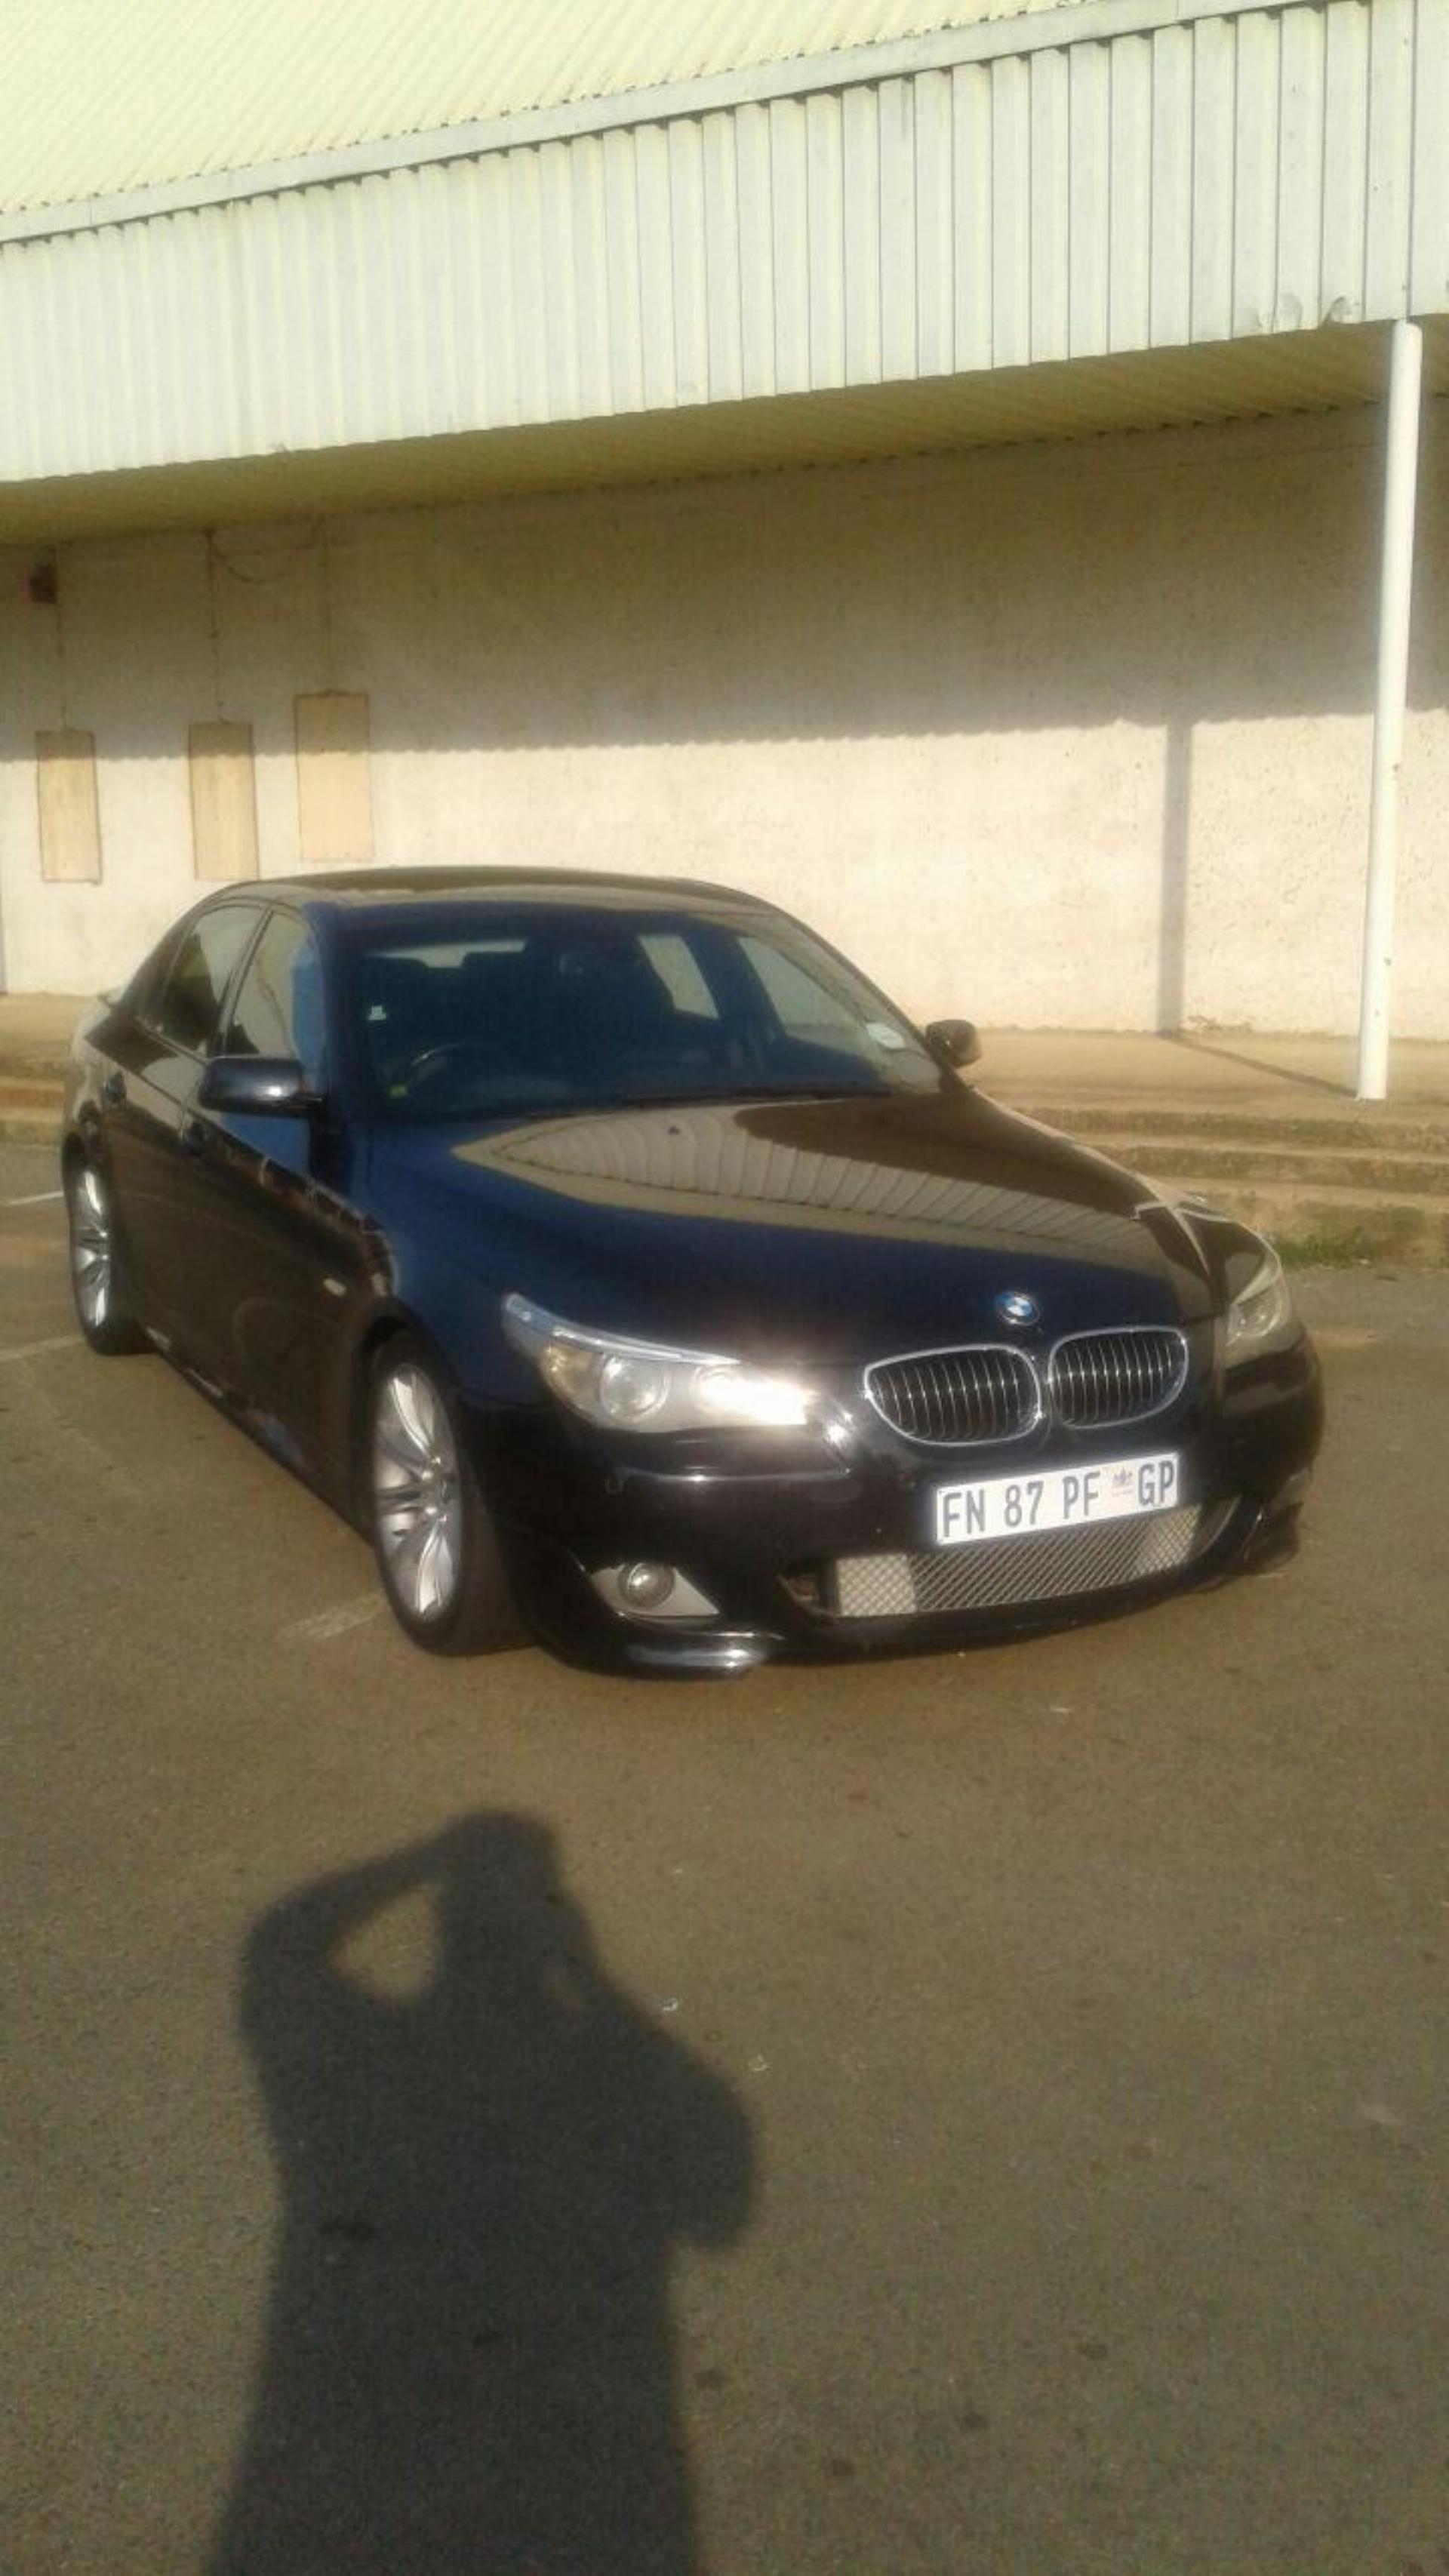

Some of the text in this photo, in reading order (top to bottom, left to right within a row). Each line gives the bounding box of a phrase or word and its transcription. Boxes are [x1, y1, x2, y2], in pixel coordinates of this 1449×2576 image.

[943, 1460, 1174, 1537] FN 87 PF GP
